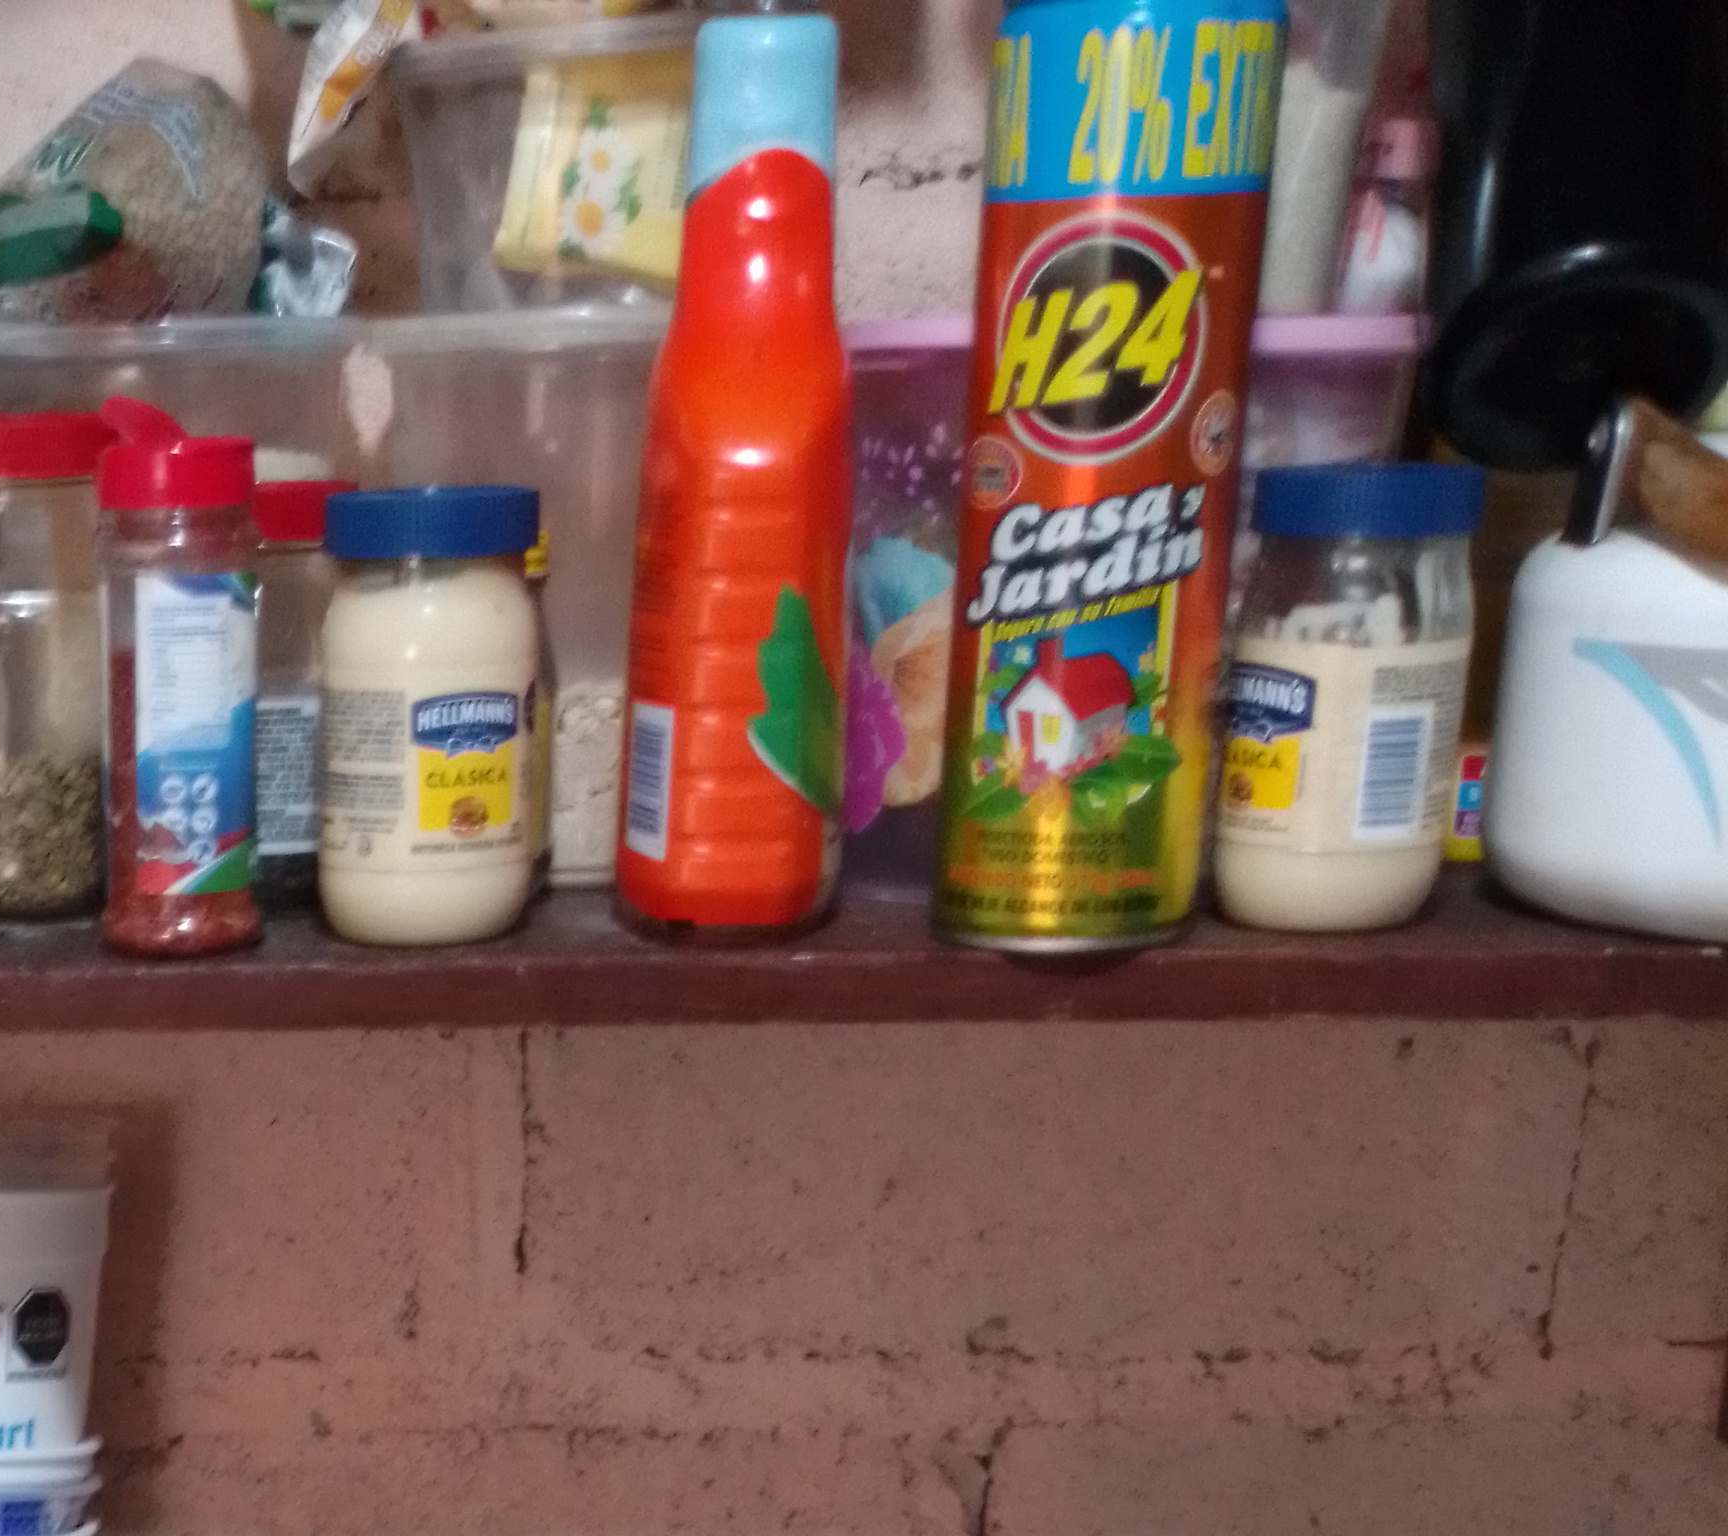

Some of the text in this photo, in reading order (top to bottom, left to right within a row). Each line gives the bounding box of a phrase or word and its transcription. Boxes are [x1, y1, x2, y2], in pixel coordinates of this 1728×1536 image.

[1068, 24, 1173, 185] 20%
[989, 268, 1200, 414] H24
[990, 483, 1174, 563] Casa
